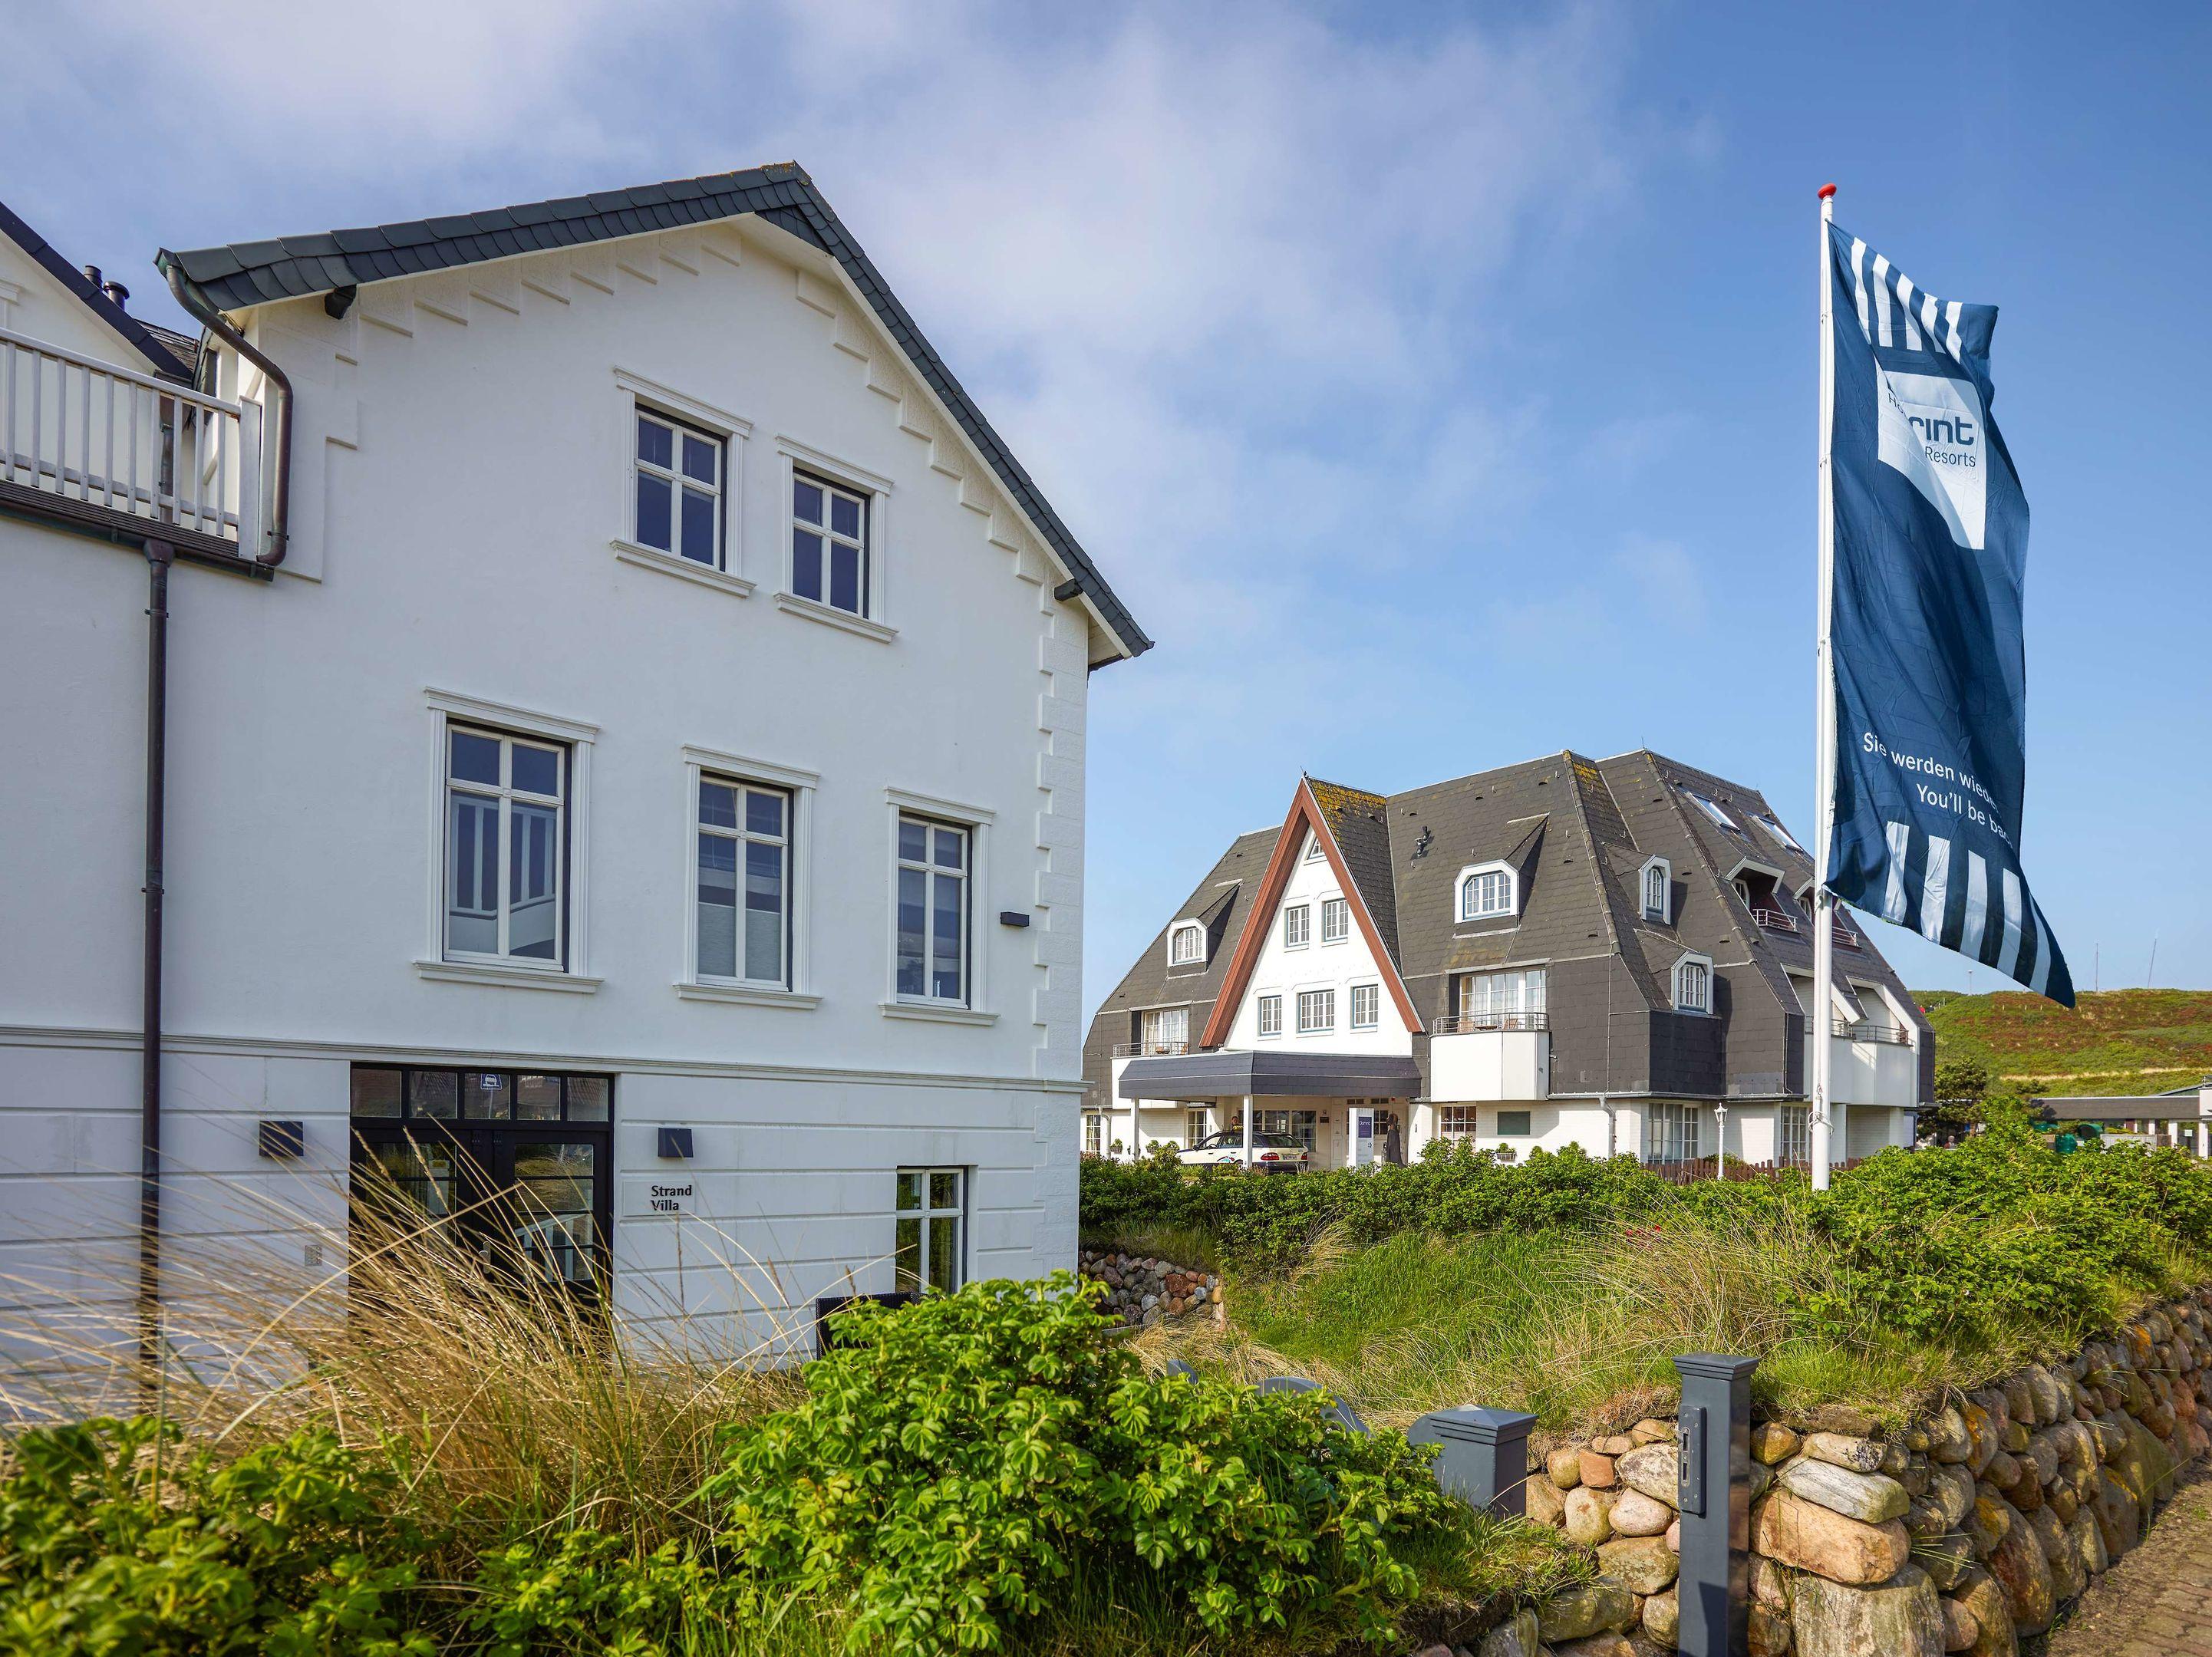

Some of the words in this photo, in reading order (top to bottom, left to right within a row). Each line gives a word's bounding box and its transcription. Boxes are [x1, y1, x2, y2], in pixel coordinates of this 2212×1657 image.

[1908, 417, 1974, 445] rint
[1925, 446, 1976, 467] Resorts
[1864, 732, 1887, 756] Sie
[1891, 751, 1954, 781] werden
[1968, 800, 1985, 825] be
[651, 1185, 692, 1197] Strand
[651, 1200, 679, 1211] Villa
